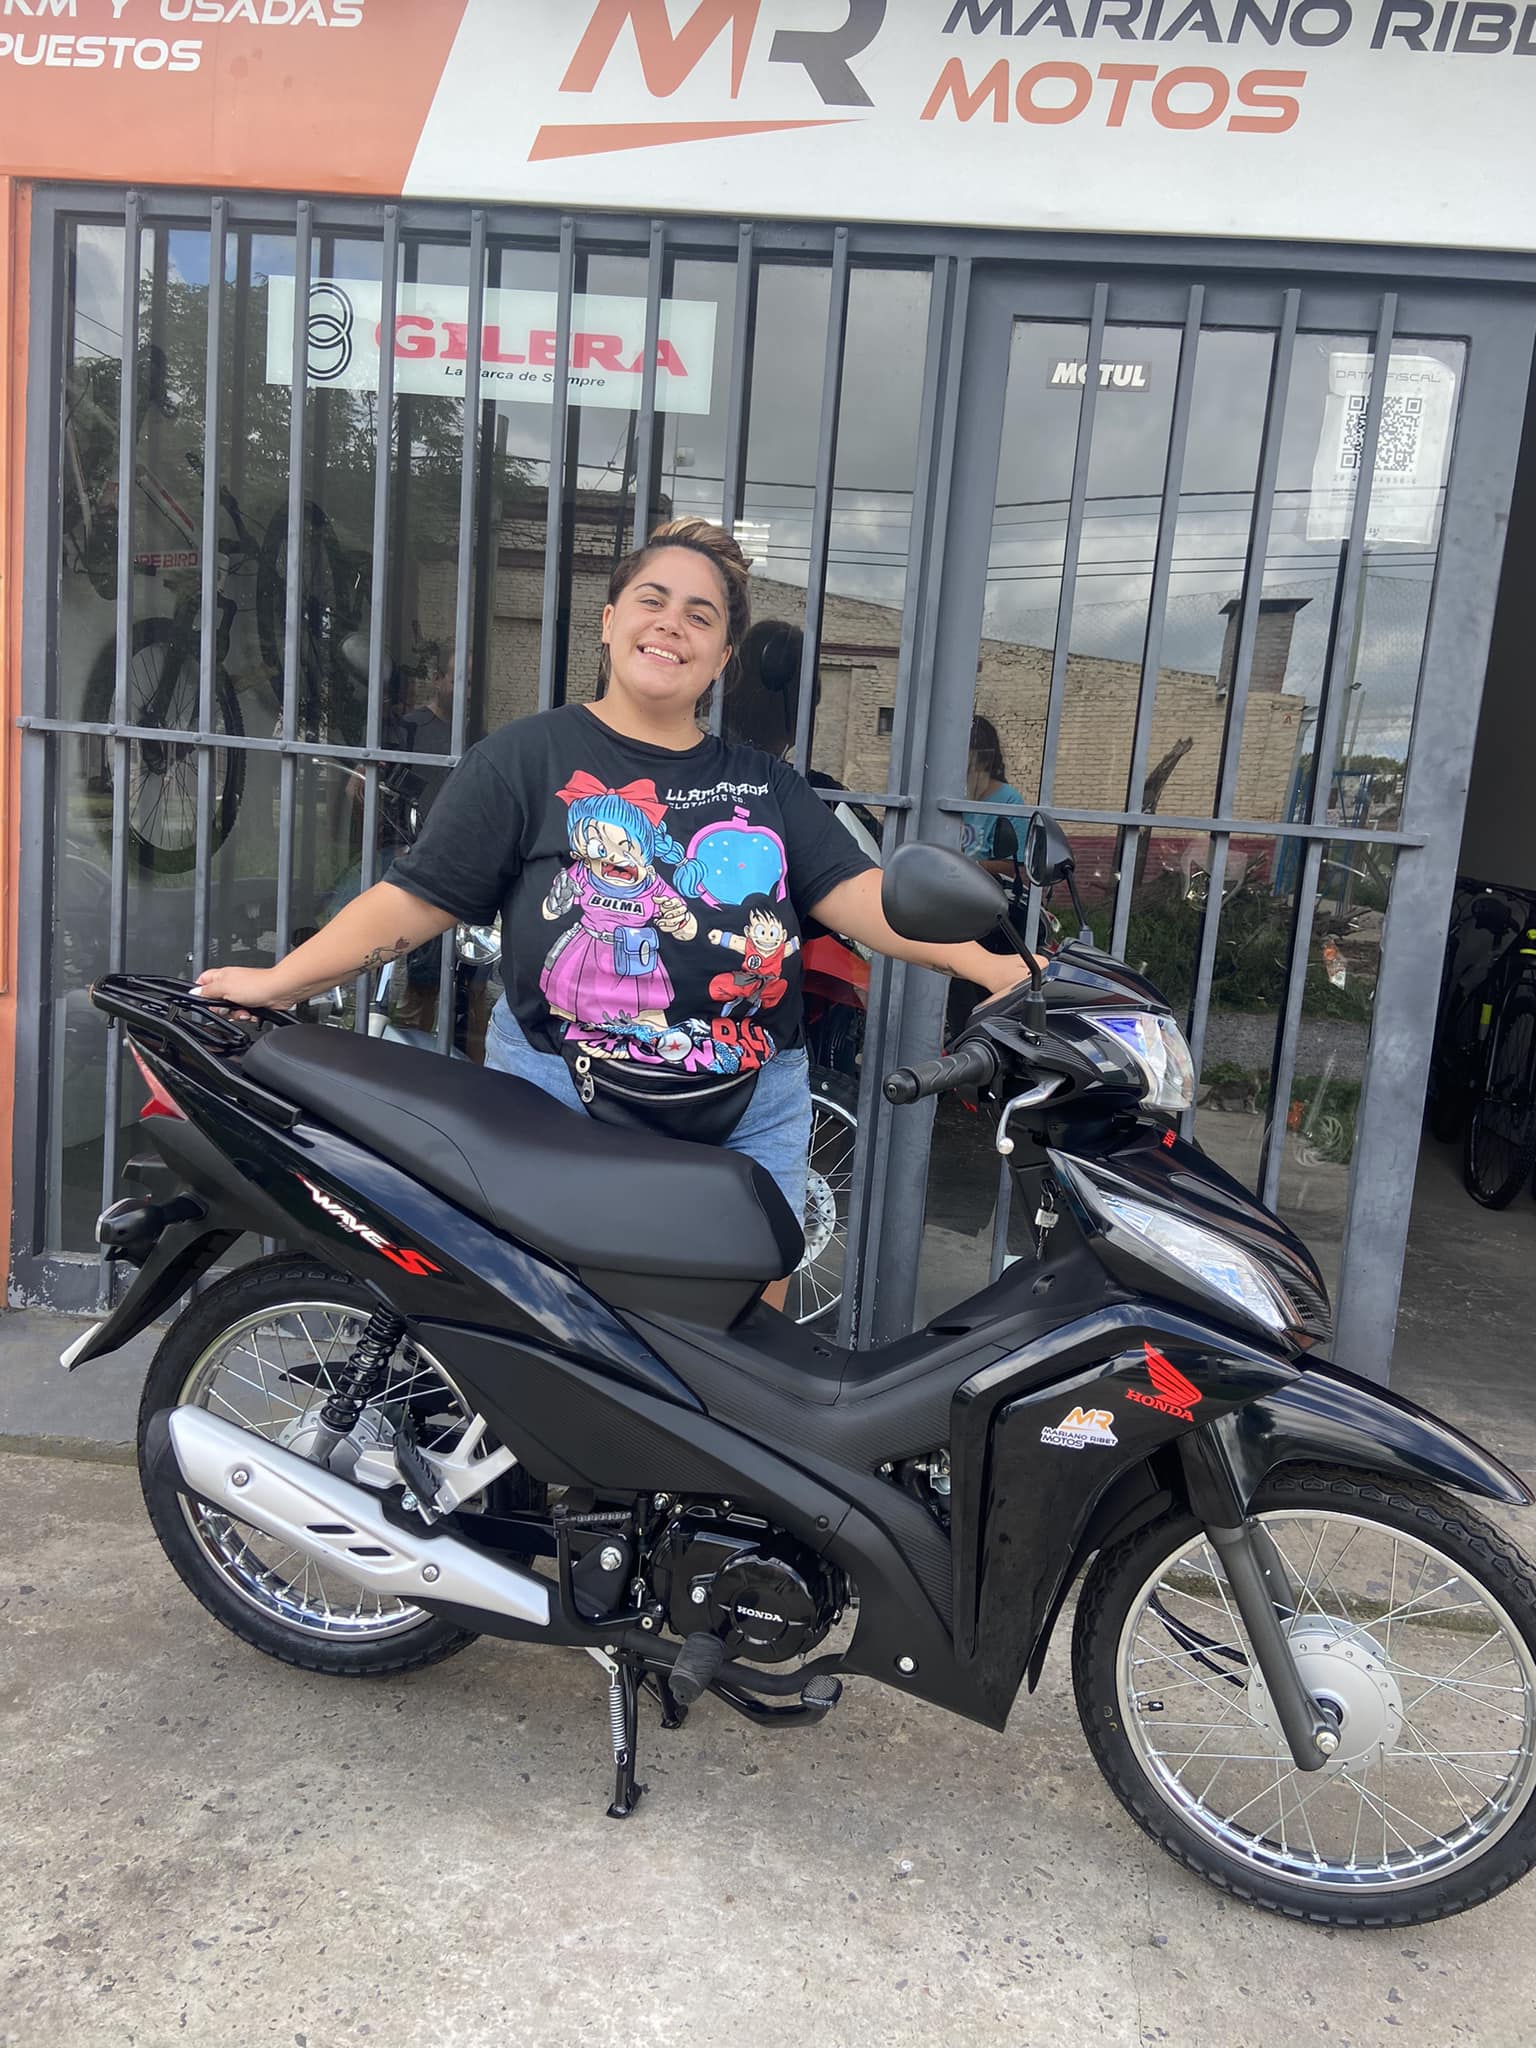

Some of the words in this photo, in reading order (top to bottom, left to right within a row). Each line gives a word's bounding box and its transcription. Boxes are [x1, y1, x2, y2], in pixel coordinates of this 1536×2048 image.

[160, 0, 365, 28] USADAS
[941, 0, 1354, 48] MARIANO
[557, 0, 876, 108] MR
[919, 57, 1307, 134] MOTOS
[375, 315, 689, 377] GILERA
[445, 365, 463, 377] La
[519, 371, 537, 382] de
[541, 372, 606, 388] Smpre
[665, 781, 769, 802] LLAMARADA
[590, 895, 643, 914] BULMA
[299, 1176, 393, 1250] WAVE
[377, 1247, 444, 1276] S
[1125, 1388, 1195, 1423] HONDA
[1066, 1408, 1113, 1431] MR
[1042, 1434, 1084, 1448] MOTOS
[1043, 1428, 1088, 1441] MARIANO
[737, 1605, 784, 1623] HONDA
